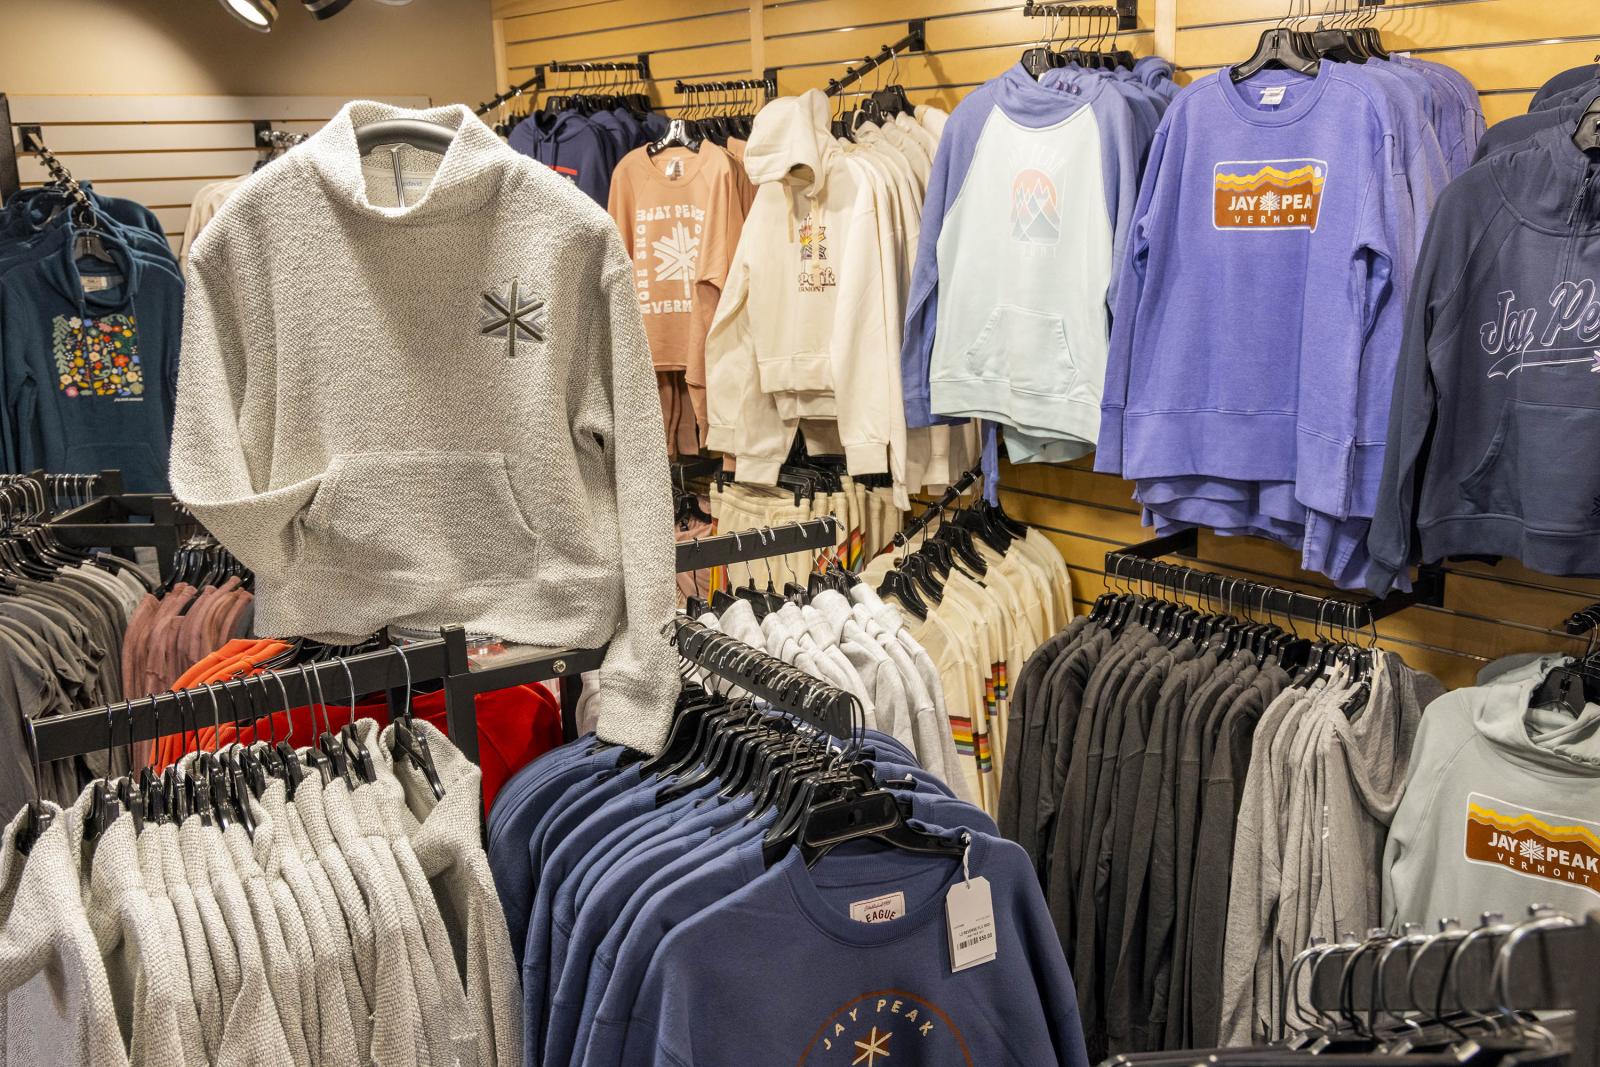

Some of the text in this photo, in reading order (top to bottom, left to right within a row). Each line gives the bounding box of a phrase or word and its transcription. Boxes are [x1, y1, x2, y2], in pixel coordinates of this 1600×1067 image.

[1228, 194, 1313, 211] JAY PEA
[646, 206, 672, 221] JAY
[1234, 214, 1307, 223] VERMON
[651, 299, 692, 314] VERM
[1480, 278, 1600, 372] Jay Pe
[1487, 832, 1600, 873] JAY PEAK
[1497, 852, 1590, 883] VERMONT
[865, 909, 896, 923] EAGUE
[823, 999, 934, 1050] JAY PEAK
